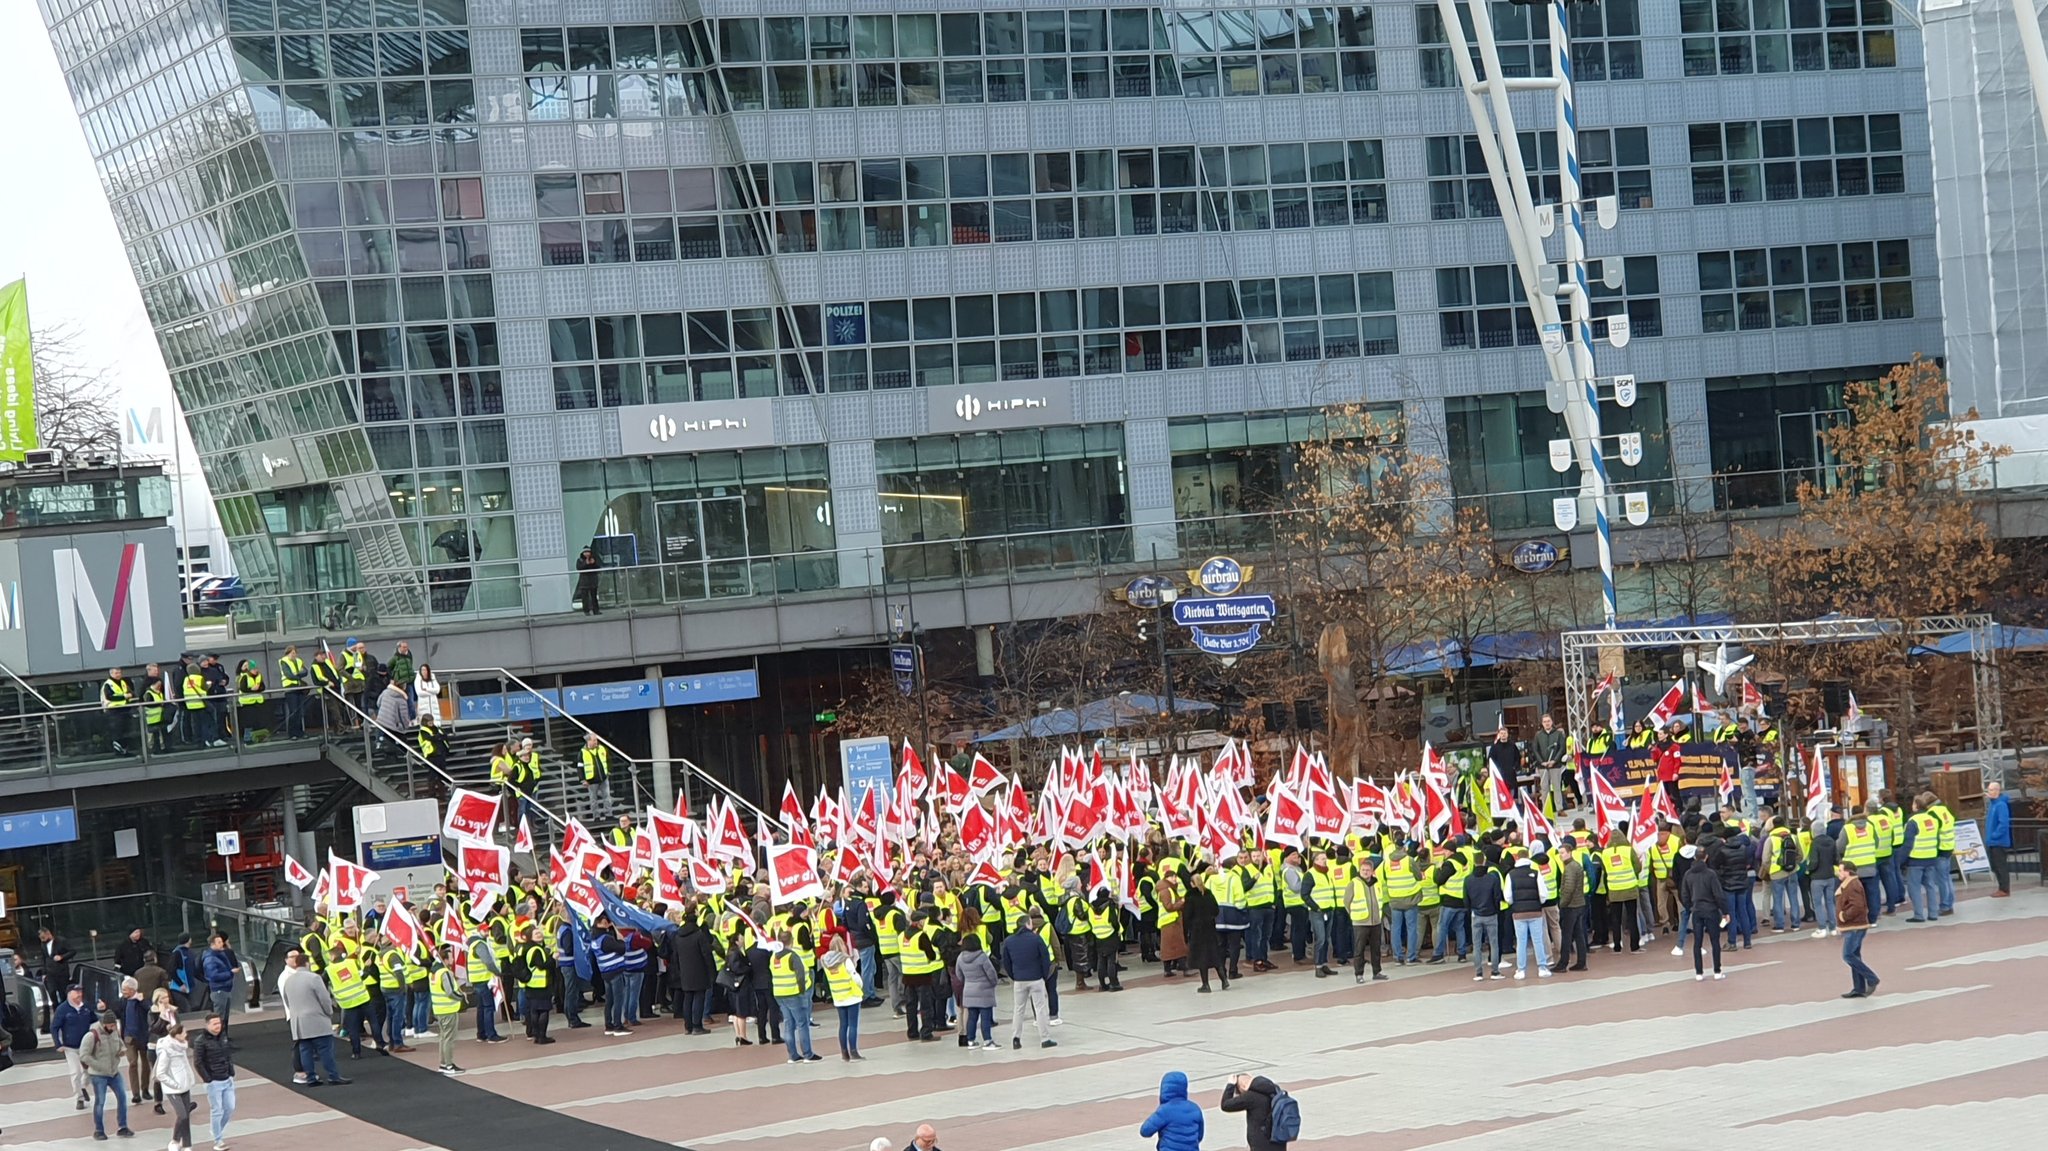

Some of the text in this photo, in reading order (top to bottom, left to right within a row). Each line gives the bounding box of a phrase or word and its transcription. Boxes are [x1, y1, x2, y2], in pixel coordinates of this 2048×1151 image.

[826, 305, 863, 318] POLIZEI
[1616, 379, 1634, 387] SGM
[1182, 603, 1266, 619] Airbräu Wirtsgarten
[1128, 810, 1139, 819] ve
[1169, 813, 1186, 822] ve
[724, 829, 737, 840] ve
[659, 835, 681, 845] ver
[466, 868, 499, 883] ver di
[779, 869, 815, 888] ver di
[447, 927, 459, 937] ve
